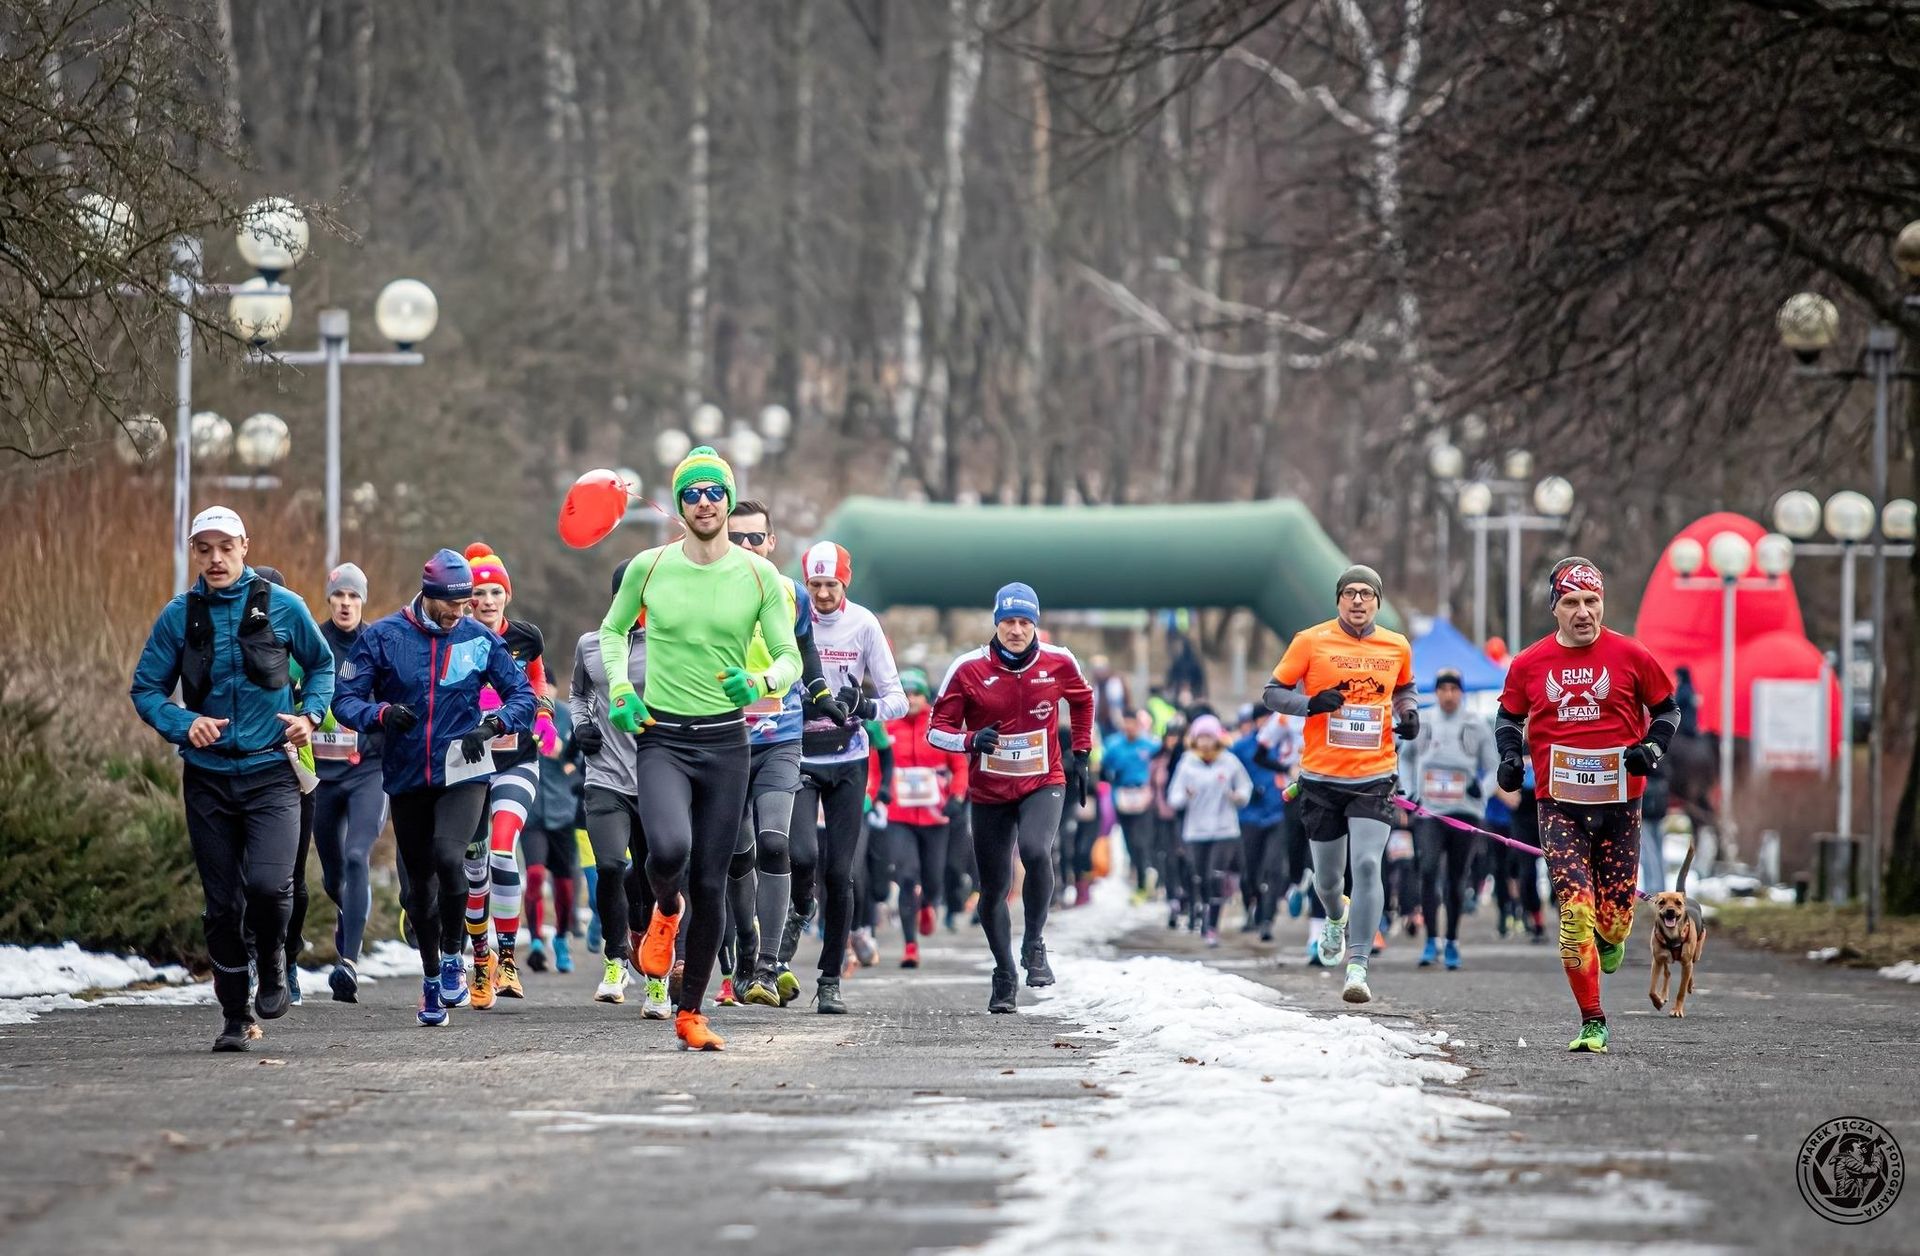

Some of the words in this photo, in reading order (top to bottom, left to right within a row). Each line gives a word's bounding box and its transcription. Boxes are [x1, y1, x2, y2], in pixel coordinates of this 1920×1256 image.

[1562, 668, 1594, 680] RUN
[1562, 678, 1594, 686] POLAND
[1559, 706, 1599, 717] TEAM
[1350, 722, 1365, 731] 100
[1012, 751, 1021, 759] 17
[1576, 772, 1596, 784] 104
